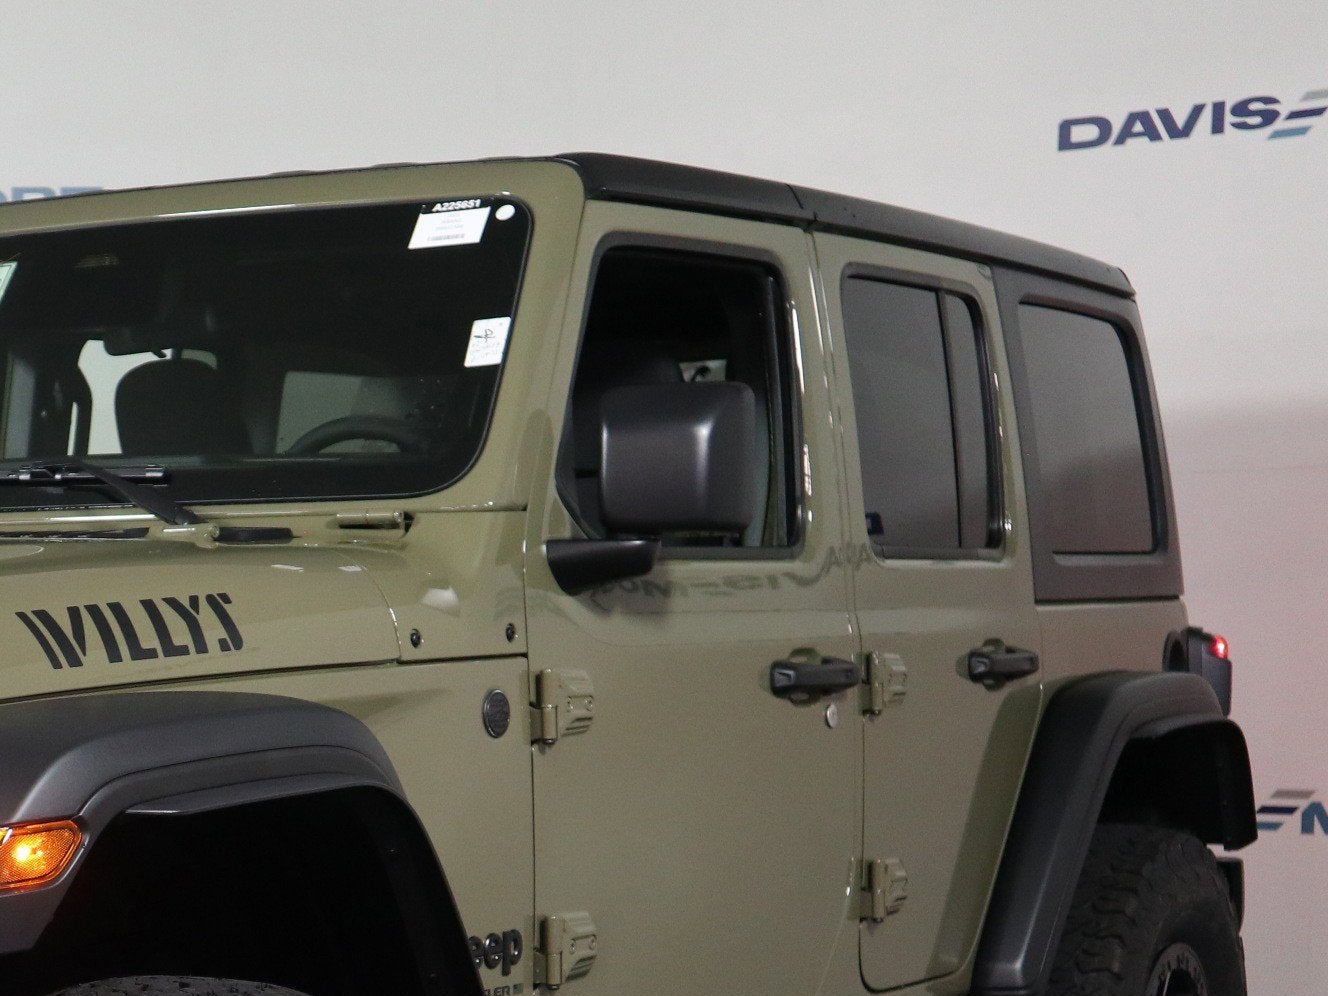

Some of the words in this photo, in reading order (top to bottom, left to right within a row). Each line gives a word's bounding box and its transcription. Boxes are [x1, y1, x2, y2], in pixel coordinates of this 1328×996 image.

[1058, 95, 1282, 152] DAVIS
[15, 592, 244, 670] WILLYS
[468, 928, 524, 977] eep
